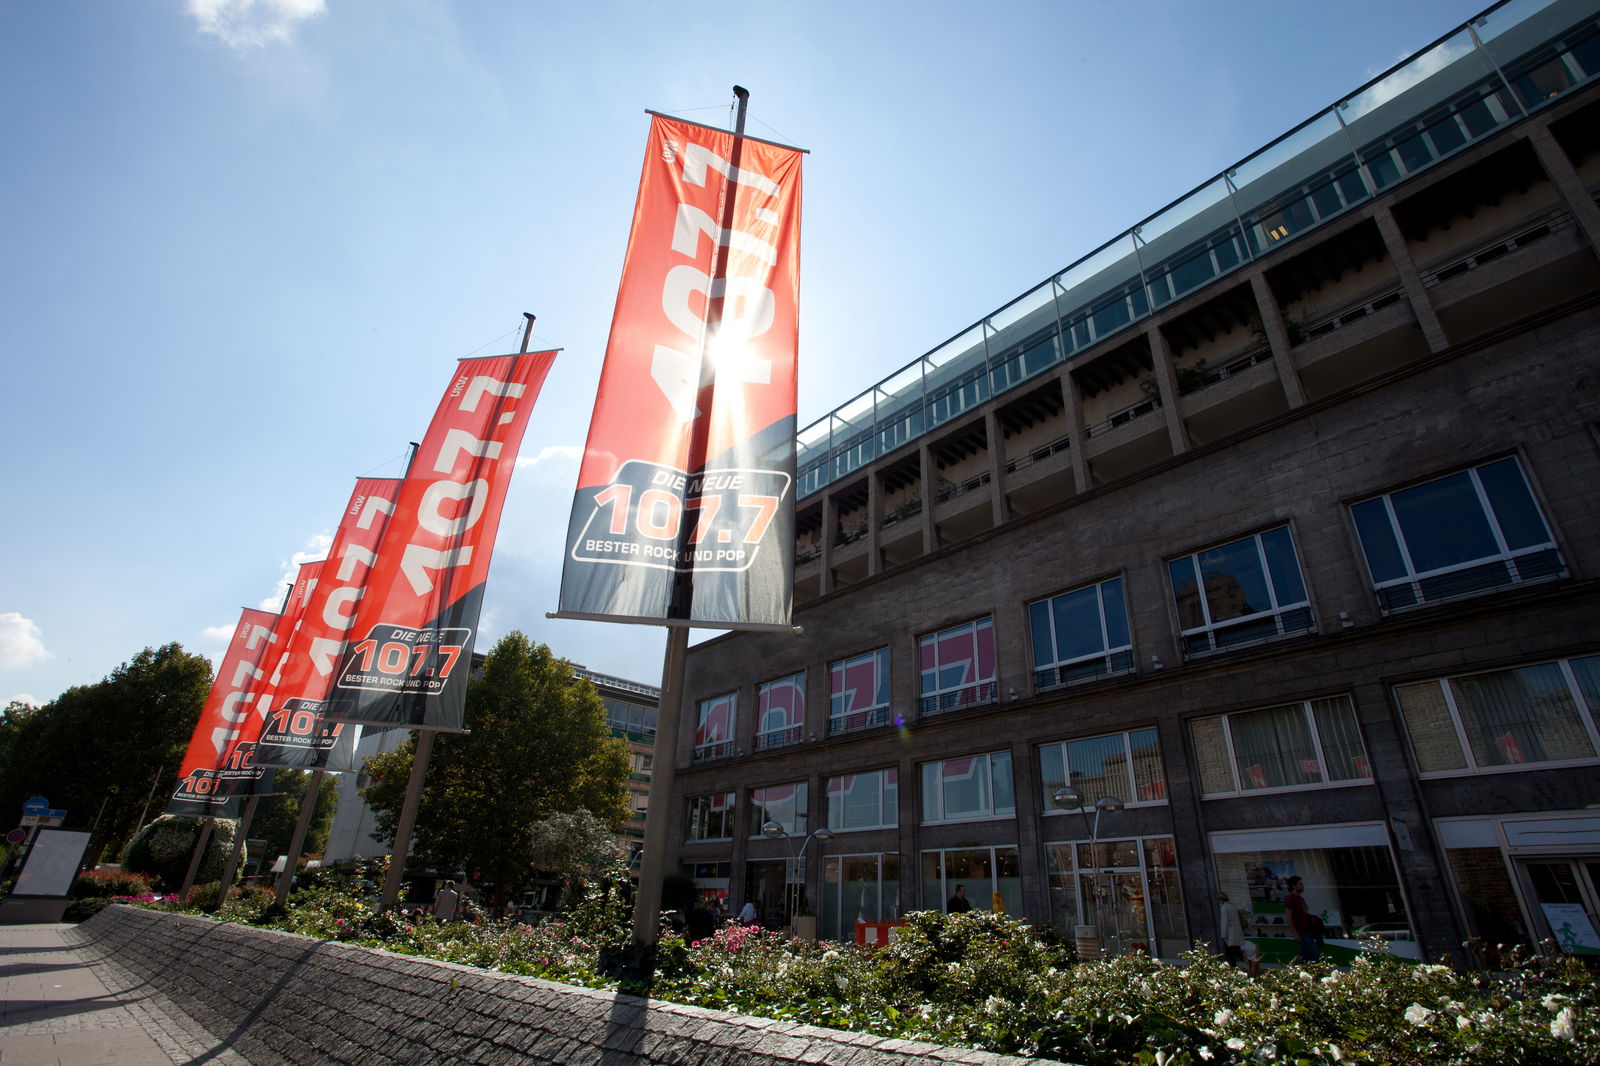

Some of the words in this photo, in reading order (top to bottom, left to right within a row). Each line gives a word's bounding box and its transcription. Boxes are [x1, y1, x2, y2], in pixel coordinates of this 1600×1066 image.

[651, 142, 780, 422] 107.7
[450, 376, 468, 397] UKW
[400, 375, 527, 596] 107.7
[652, 471, 686, 491] DIE
[688, 474, 744, 494] NEUE
[350, 494, 365, 516] UKW
[594, 484, 779, 544] 107.7
[585, 540, 639, 555] BESTER
[644, 545, 680, 561] ROCK
[684, 550, 713, 562] UND
[716, 550, 745, 561] POP
[390, 629, 416, 642] DIE
[354, 639, 462, 678] 107.7
[346, 674, 378, 684] BESTER
[380, 677, 405, 686] ROCK
[301, 701, 319, 711] DIE
[266, 735, 291, 743] BESTER
[292, 737, 312, 745] ROCK
